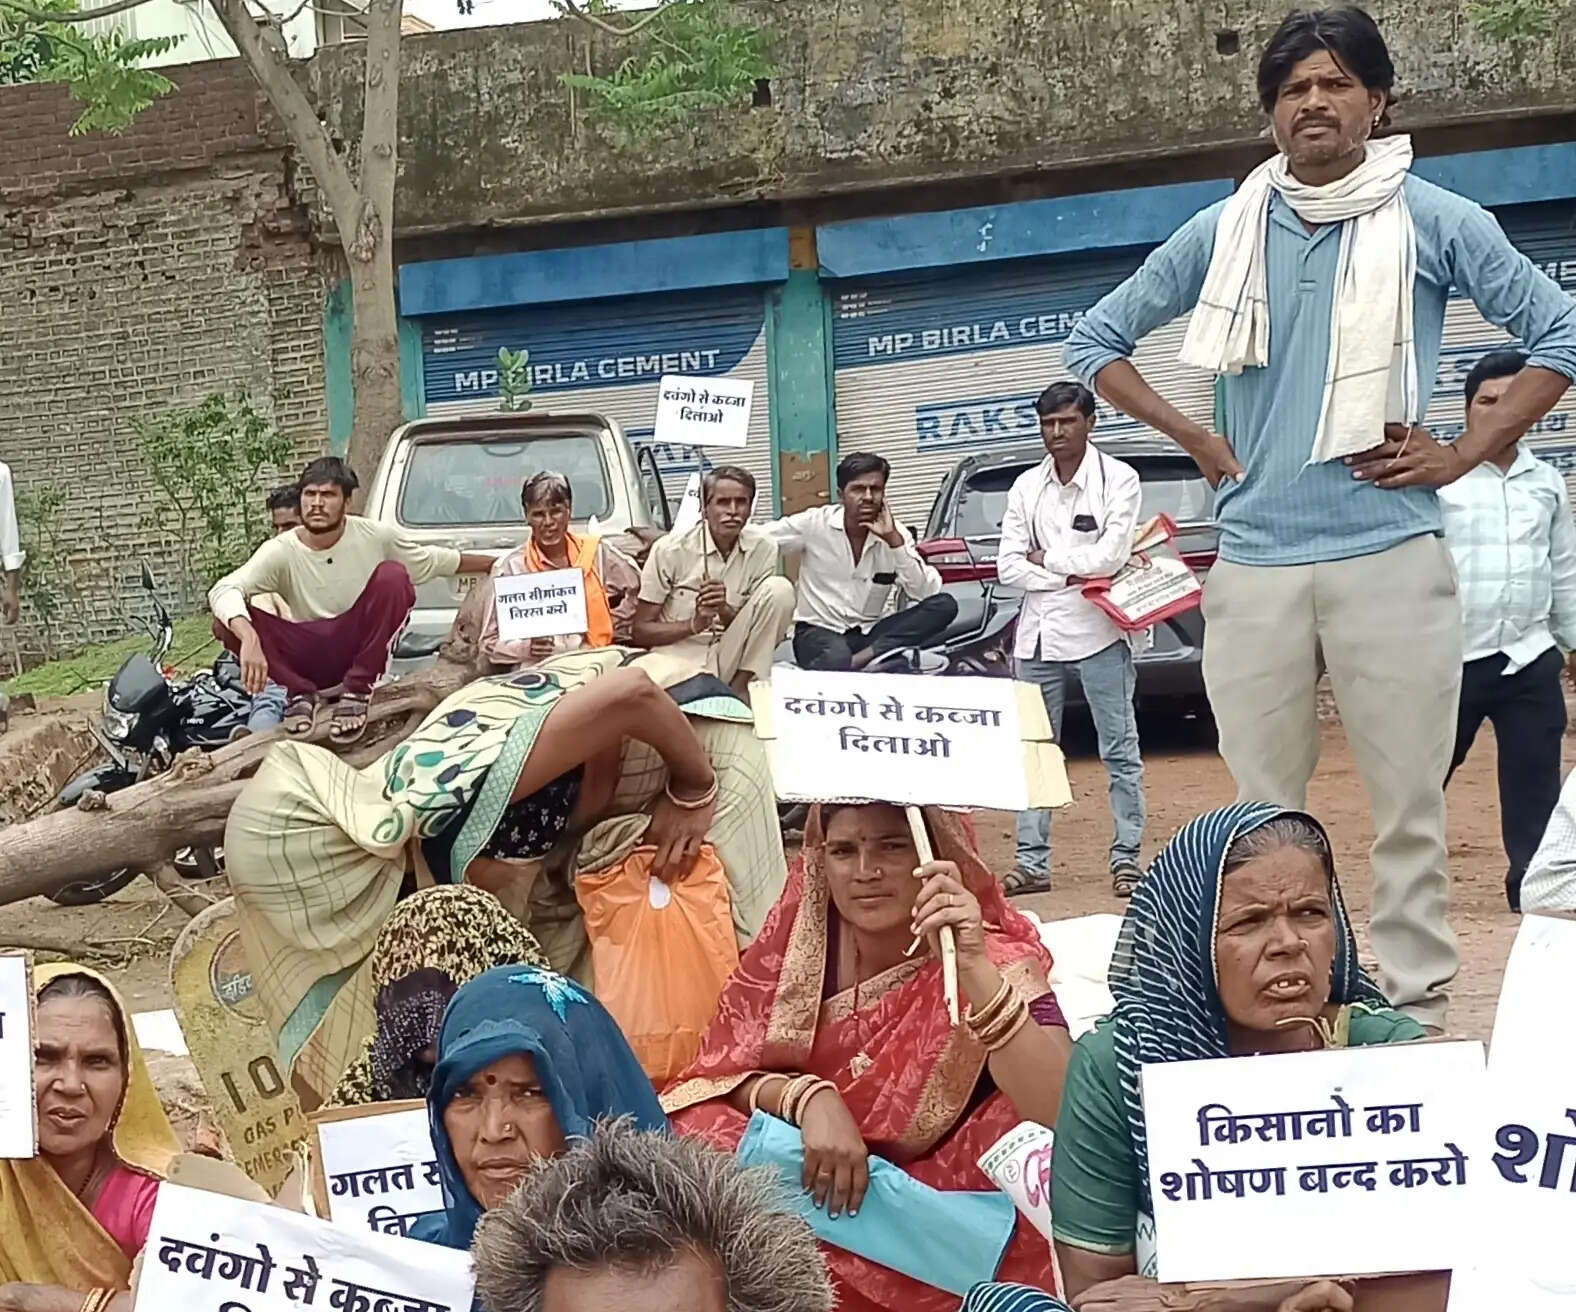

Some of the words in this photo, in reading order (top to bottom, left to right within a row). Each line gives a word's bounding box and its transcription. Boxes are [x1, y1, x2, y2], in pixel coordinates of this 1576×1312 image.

[868, 333, 913, 357] MP
[922, 319, 1010, 349] BIRLA
[1019, 312, 1085, 338] CEM
[455, 370, 498, 392] MP
[597, 350, 720, 379] CEMENT
[546, 602, 569, 616] करो
[879, 695, 905, 721] से
[838, 725, 952, 758] दिलाओ
[221, 1055, 285, 1114] 10
[244, 1116, 277, 1145] GAS
[1197, 1095, 1354, 1147] किसानो
[1364, 1103, 1423, 1135] का
[330, 1164, 415, 1198] गलत
[1159, 1158, 1287, 1202] शोषण
[1297, 1161, 1379, 1194] बन्द
[1387, 1143, 1469, 1188] करो
[283, 1254, 323, 1305] से
